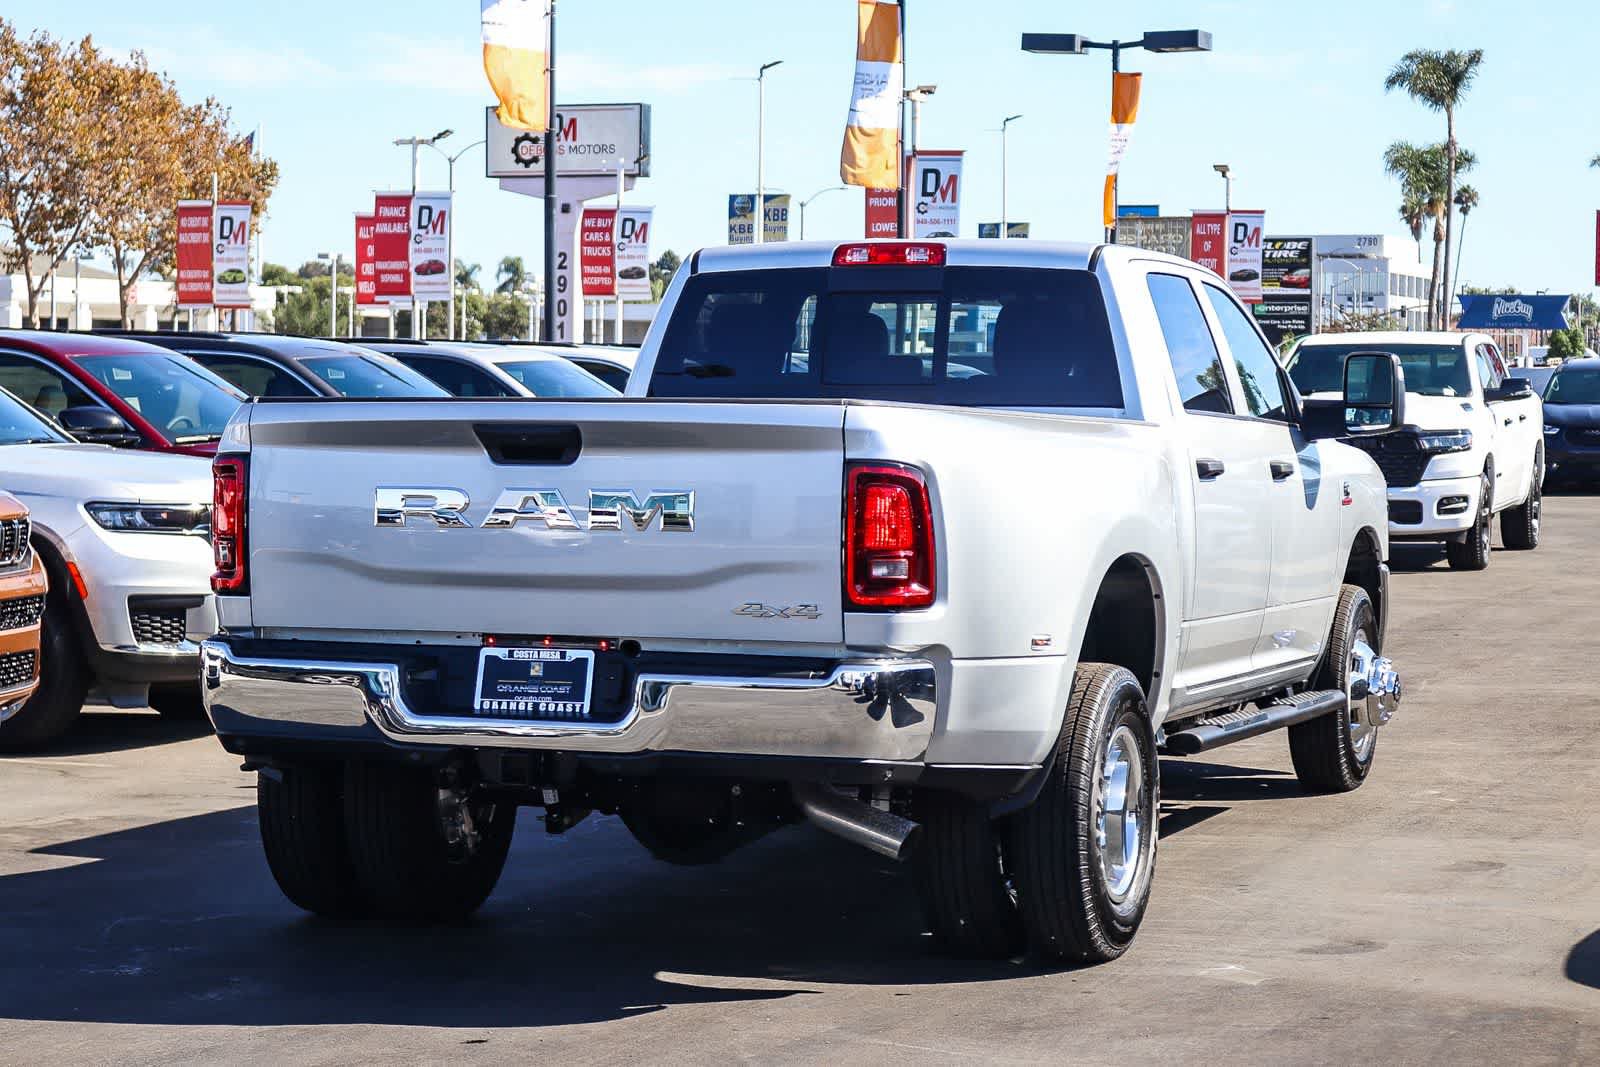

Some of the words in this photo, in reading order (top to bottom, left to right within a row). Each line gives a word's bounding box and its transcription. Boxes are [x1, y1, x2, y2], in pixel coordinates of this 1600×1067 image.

[520, 144, 565, 157] DEBS
[568, 143, 617, 155] MOTORS
[921, 167, 959, 204] DM
[869, 197, 897, 208] PRIORI
[379, 206, 407, 217] FINANCE
[763, 207, 788, 222] KBB
[417, 204, 447, 236] DM
[584, 217, 597, 228] WE
[597, 217, 613, 228] BUY
[219, 215, 247, 246] DM
[376, 222, 409, 233] AVAILABLE
[621, 216, 649, 244] DM
[729, 223, 754, 234] KBB
[1196, 223, 1208, 235] ALL
[1208, 223, 1221, 235] TYPE
[585, 232, 604, 242] CARS
[604, 232, 611, 241] &
[1233, 222, 1261, 249] DM
[584, 246, 611, 257] TRUCKS
[1203, 240, 1212, 252] OF
[1263, 250, 1301, 258] TIRE
[361, 262, 375, 276] CRE
[358, 281, 376, 294] WELC
[557, 251, 568, 340] 2901
[374, 486, 695, 532] RAM
[513, 650, 538, 660] COSTA
[539, 650, 561, 661] MESA
[540, 685, 572, 695] COAST
[482, 700, 534, 711] ORANGE
[538, 702, 583, 713] COAST
